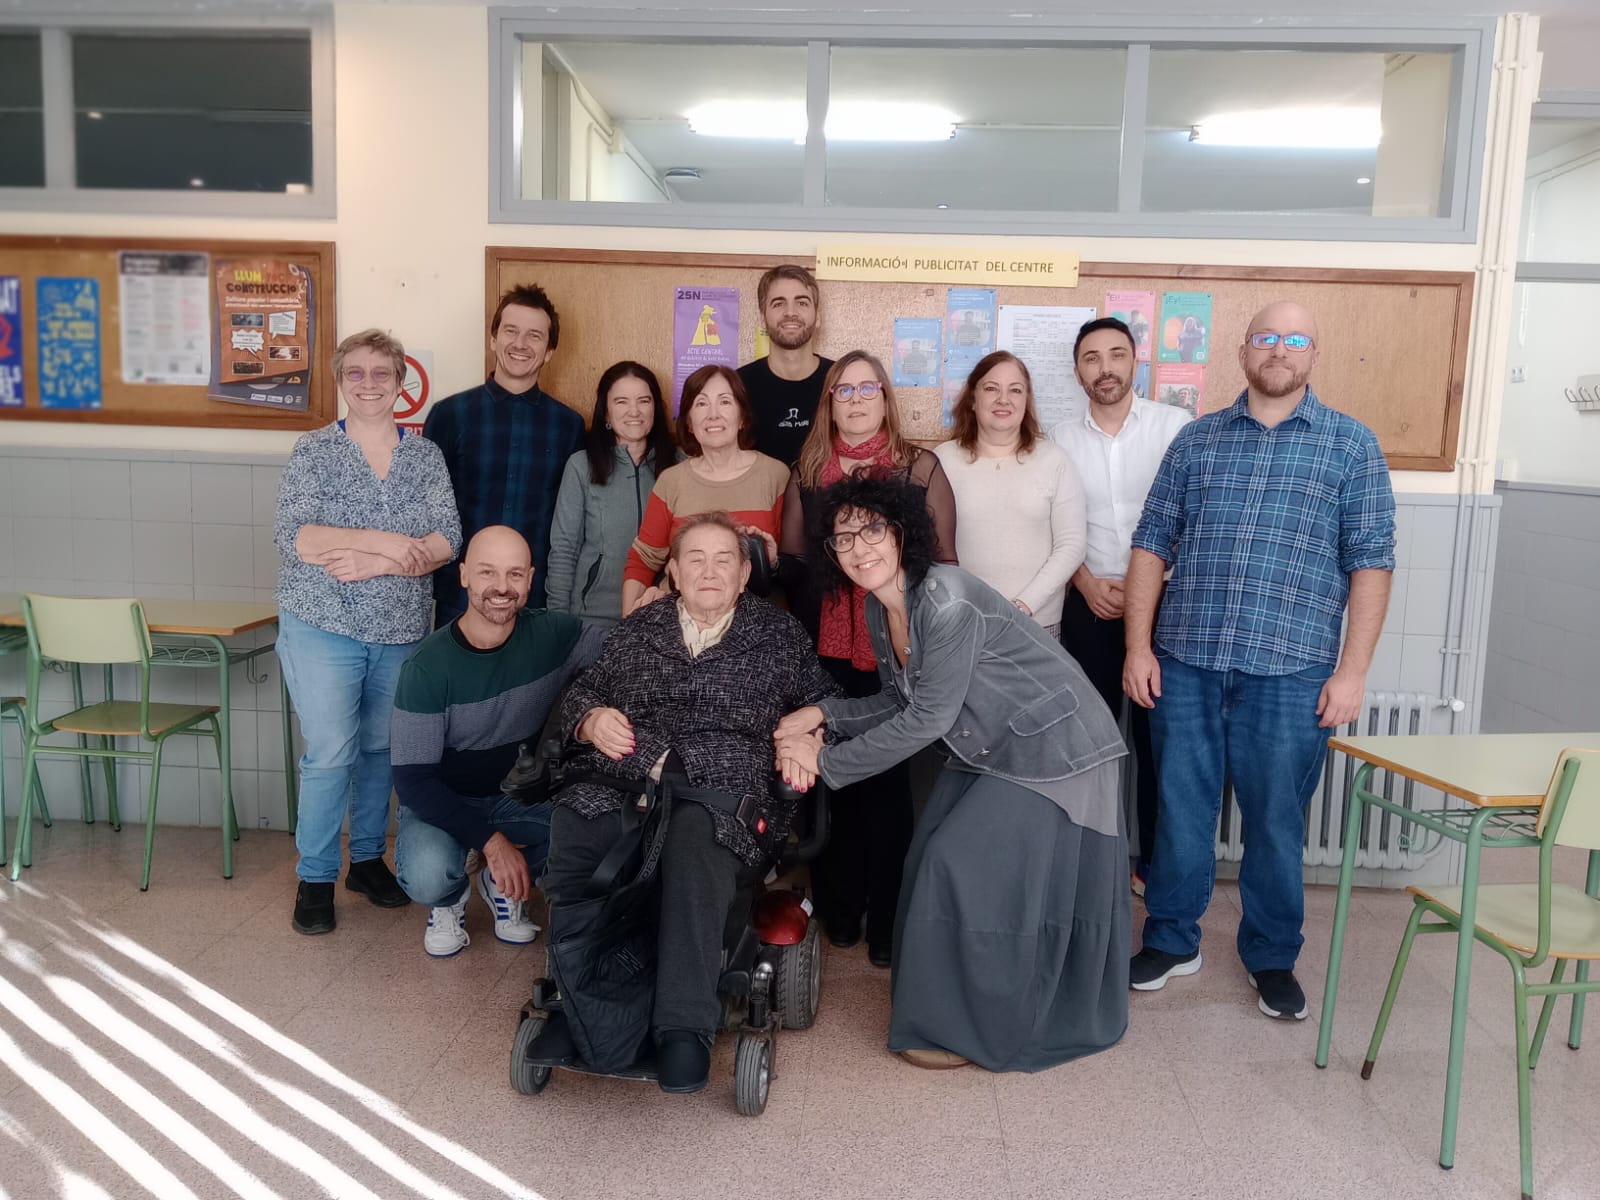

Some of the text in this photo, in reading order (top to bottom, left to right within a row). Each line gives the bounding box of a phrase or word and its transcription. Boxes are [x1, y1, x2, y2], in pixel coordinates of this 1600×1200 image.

[827, 255, 901, 269] INFORMACIÓ
[914, 259, 979, 271] PUBLICITAT
[985, 261, 1007, 272] DEL
[1010, 262, 1054, 273] CENTRE
[677, 290, 701, 300] 25N
